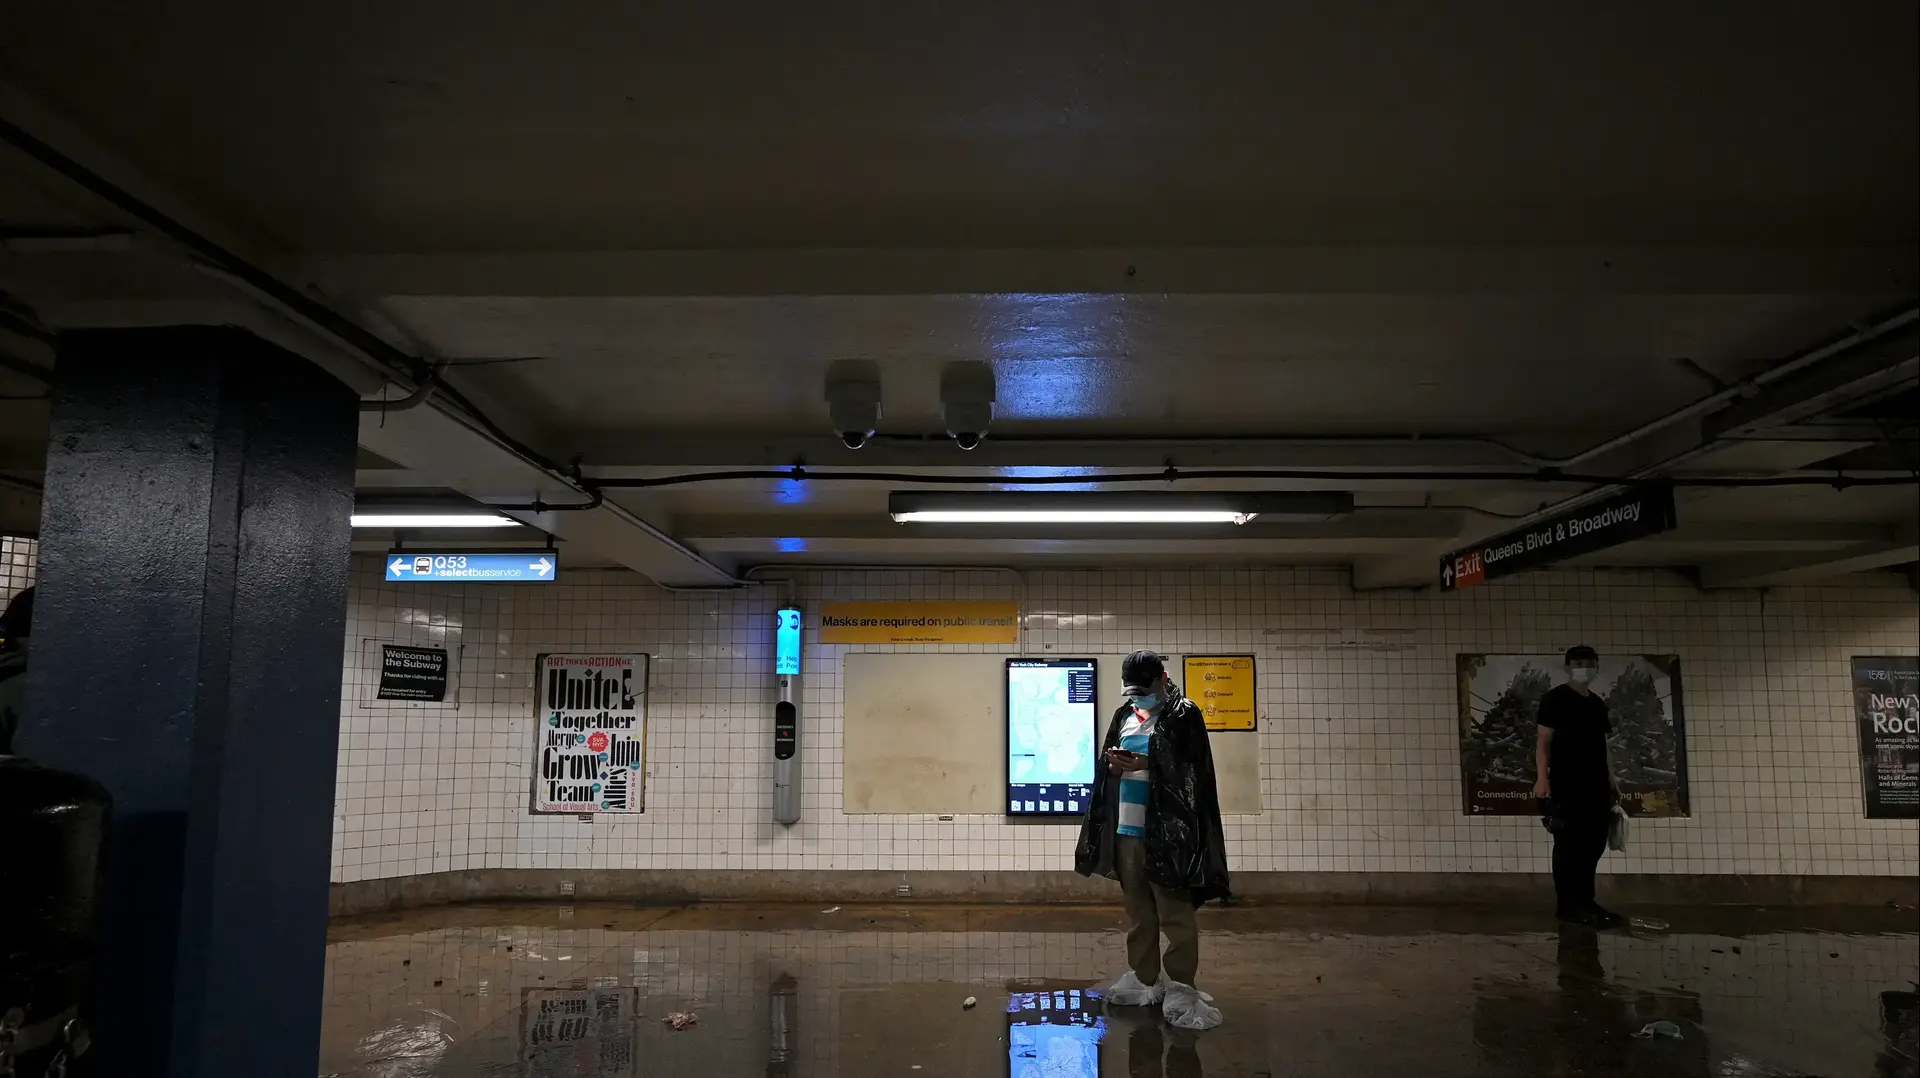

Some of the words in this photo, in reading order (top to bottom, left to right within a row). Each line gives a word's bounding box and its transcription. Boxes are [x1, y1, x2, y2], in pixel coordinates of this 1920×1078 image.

[1455, 552, 1481, 579] Exit
[1484, 540, 1523, 564] Queens
[1526, 528, 1552, 551] Blvd
[1556, 524, 1566, 542] &
[1569, 502, 1641, 538] Broadway
[434, 556, 467, 569] Q53
[822, 616, 858, 626] Masks
[860, 618, 878, 626] are
[879, 616, 925, 629] required
[928, 618, 942, 626] on
[944, 616, 976, 629] public
[978, 616, 1013, 626] transit
[385, 650, 431, 660] Welcome
[548, 657, 565, 666] ART
[588, 657, 621, 666] ACTION
[385, 658, 402, 666] the
[403, 660, 441, 671] Subway
[1871, 693, 1910, 709] New
[552, 712, 636, 732] Together
[1873, 711, 1919, 733] Roc
[546, 730, 577, 749] Merge
[606, 734, 640, 766] Join
[543, 747, 600, 780] Grow
[547, 781, 594, 801] Team
[604, 769, 627, 809] Allies
[1477, 790, 1527, 800] Connecting
[543, 803, 561, 811] School
[570, 803, 586, 811] Visual
[587, 803, 598, 811] Arts
